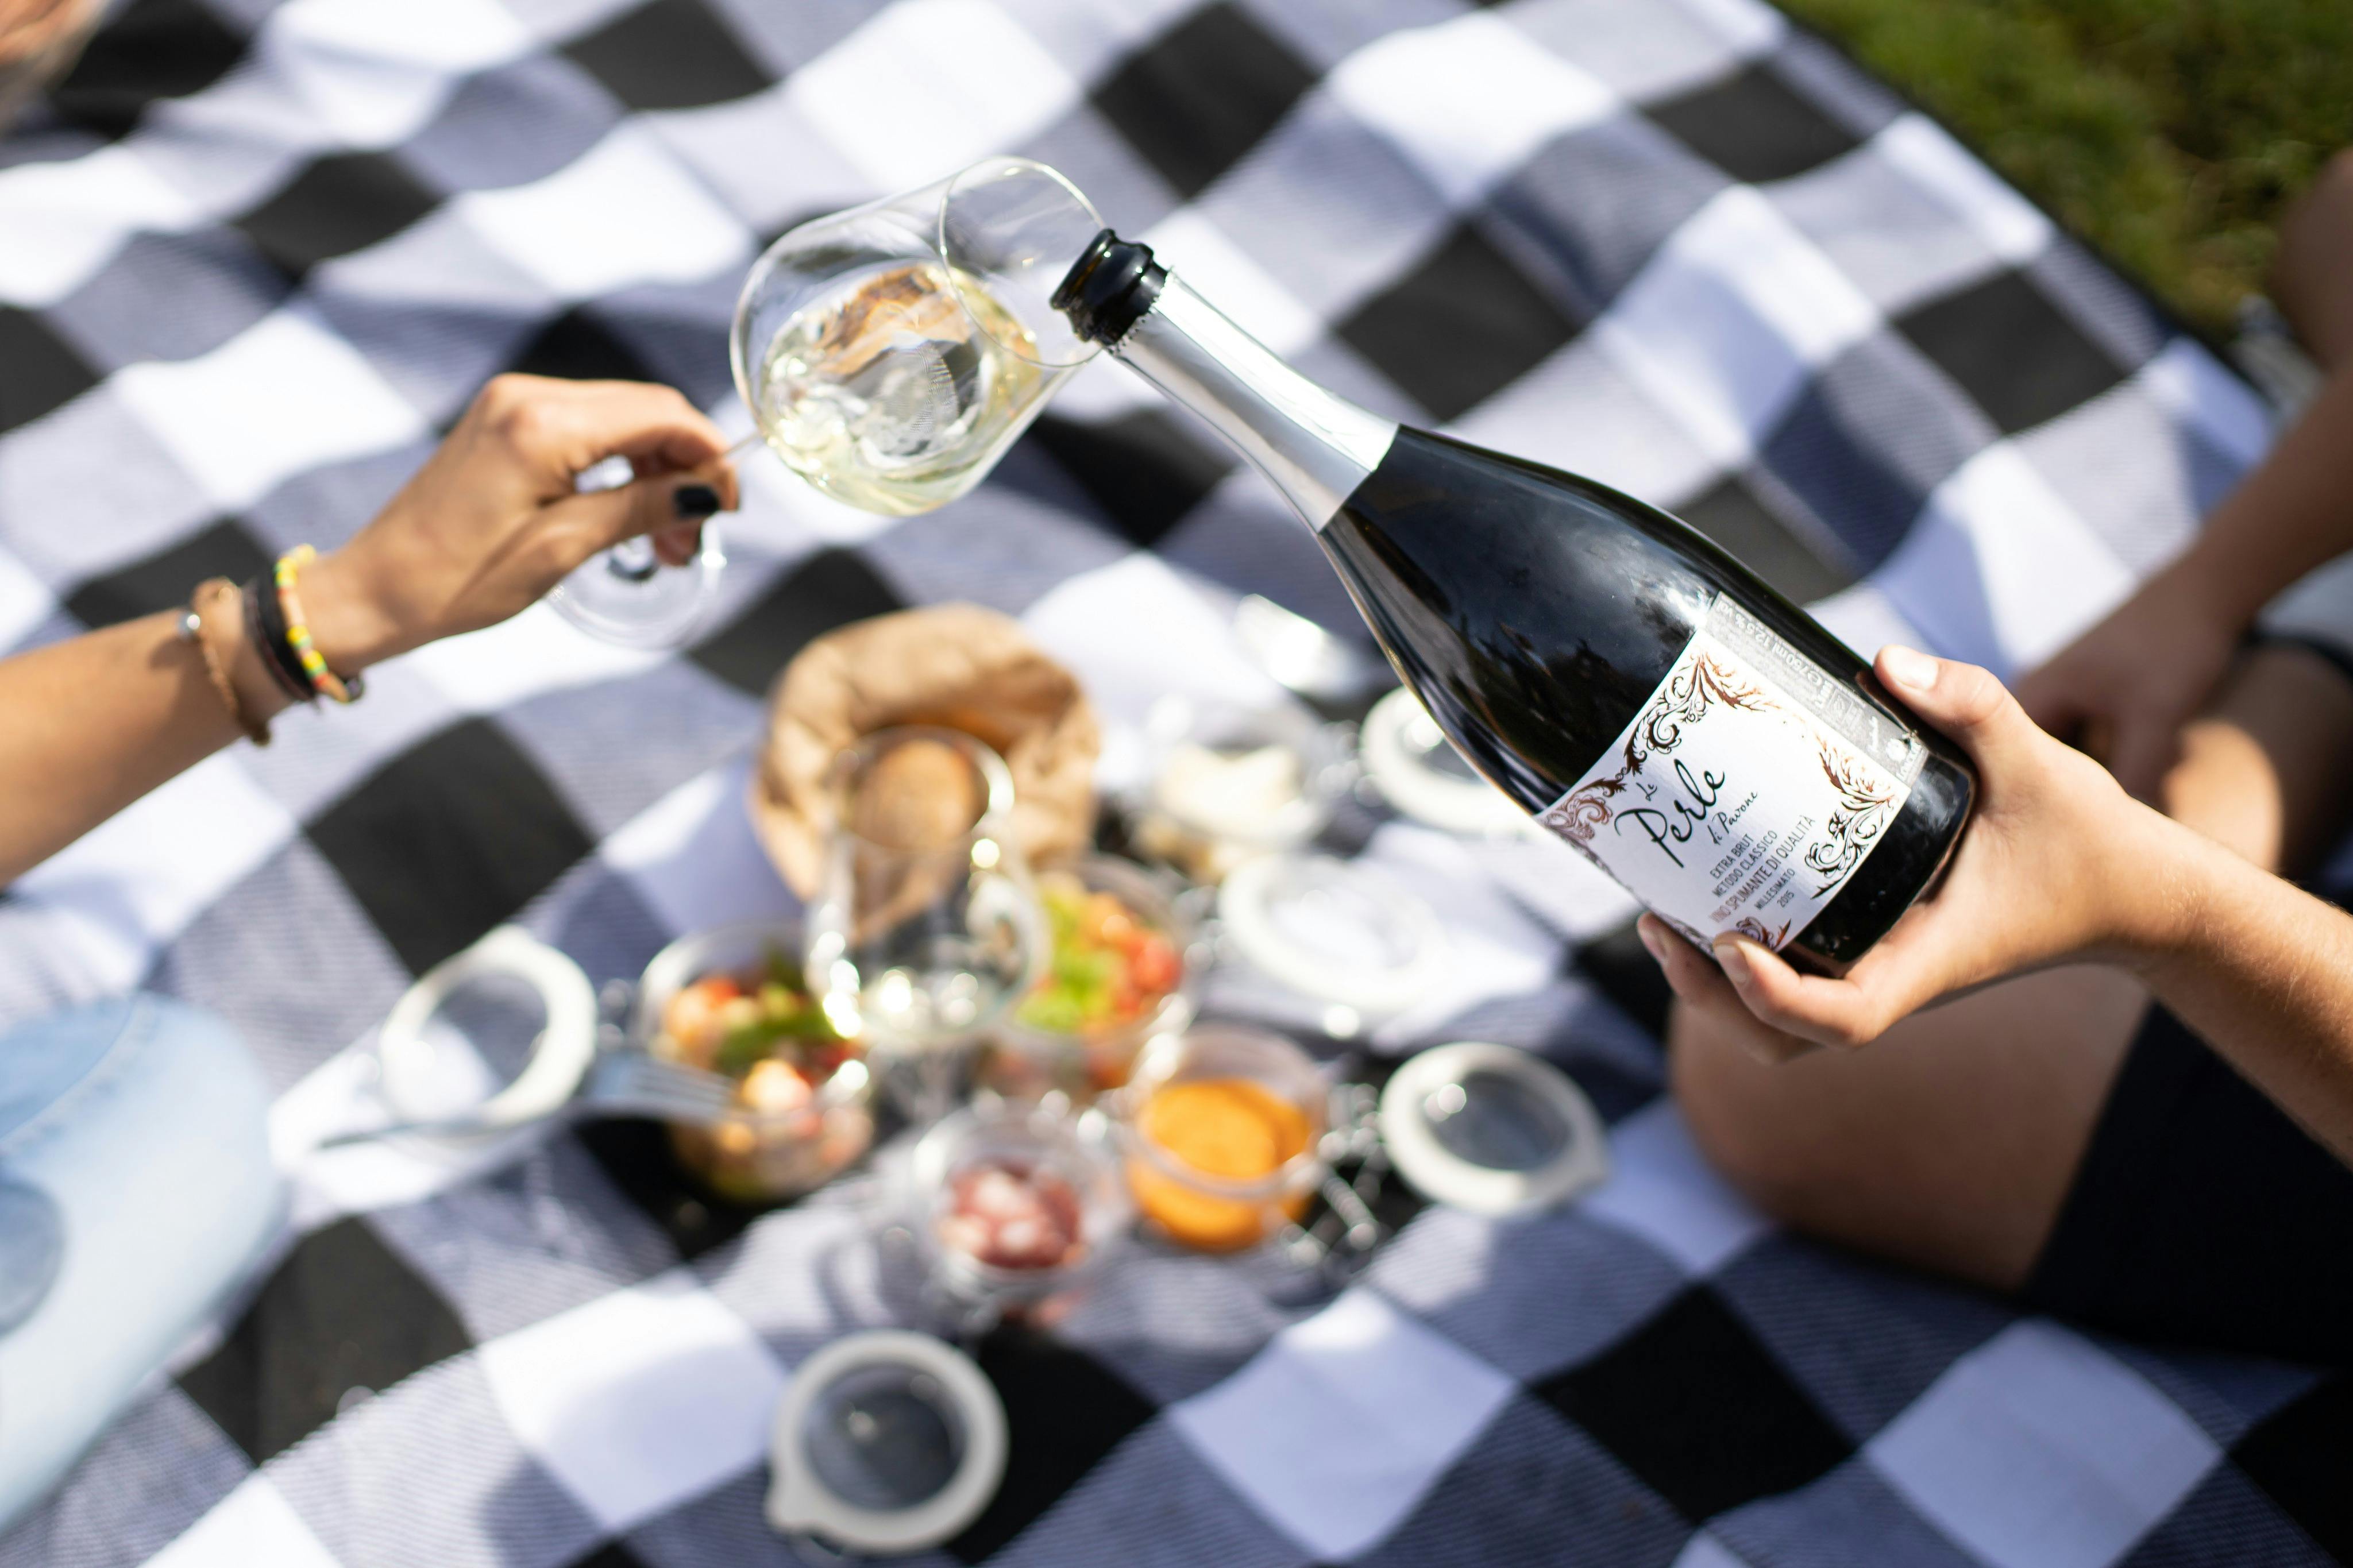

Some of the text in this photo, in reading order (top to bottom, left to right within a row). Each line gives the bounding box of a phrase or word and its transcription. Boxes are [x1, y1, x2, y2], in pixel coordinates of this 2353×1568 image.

[1716, 601, 1734, 617] vol
[1614, 758, 1725, 868] Perle
[1635, 782, 1658, 802] Le
[1711, 790, 1758, 834] Pavone
[1710, 833, 1754, 879] EXTRA BRUT
[1711, 830, 1778, 898] METODO CLASSICO
[1725, 865, 1773, 910] SPUMANTE
[1765, 855, 1782, 871] DI
[1776, 814, 1816, 859] QUALITÀ
[1754, 867, 1796, 910] MILLESIMATO
[1776, 890, 1795, 908] 2015
